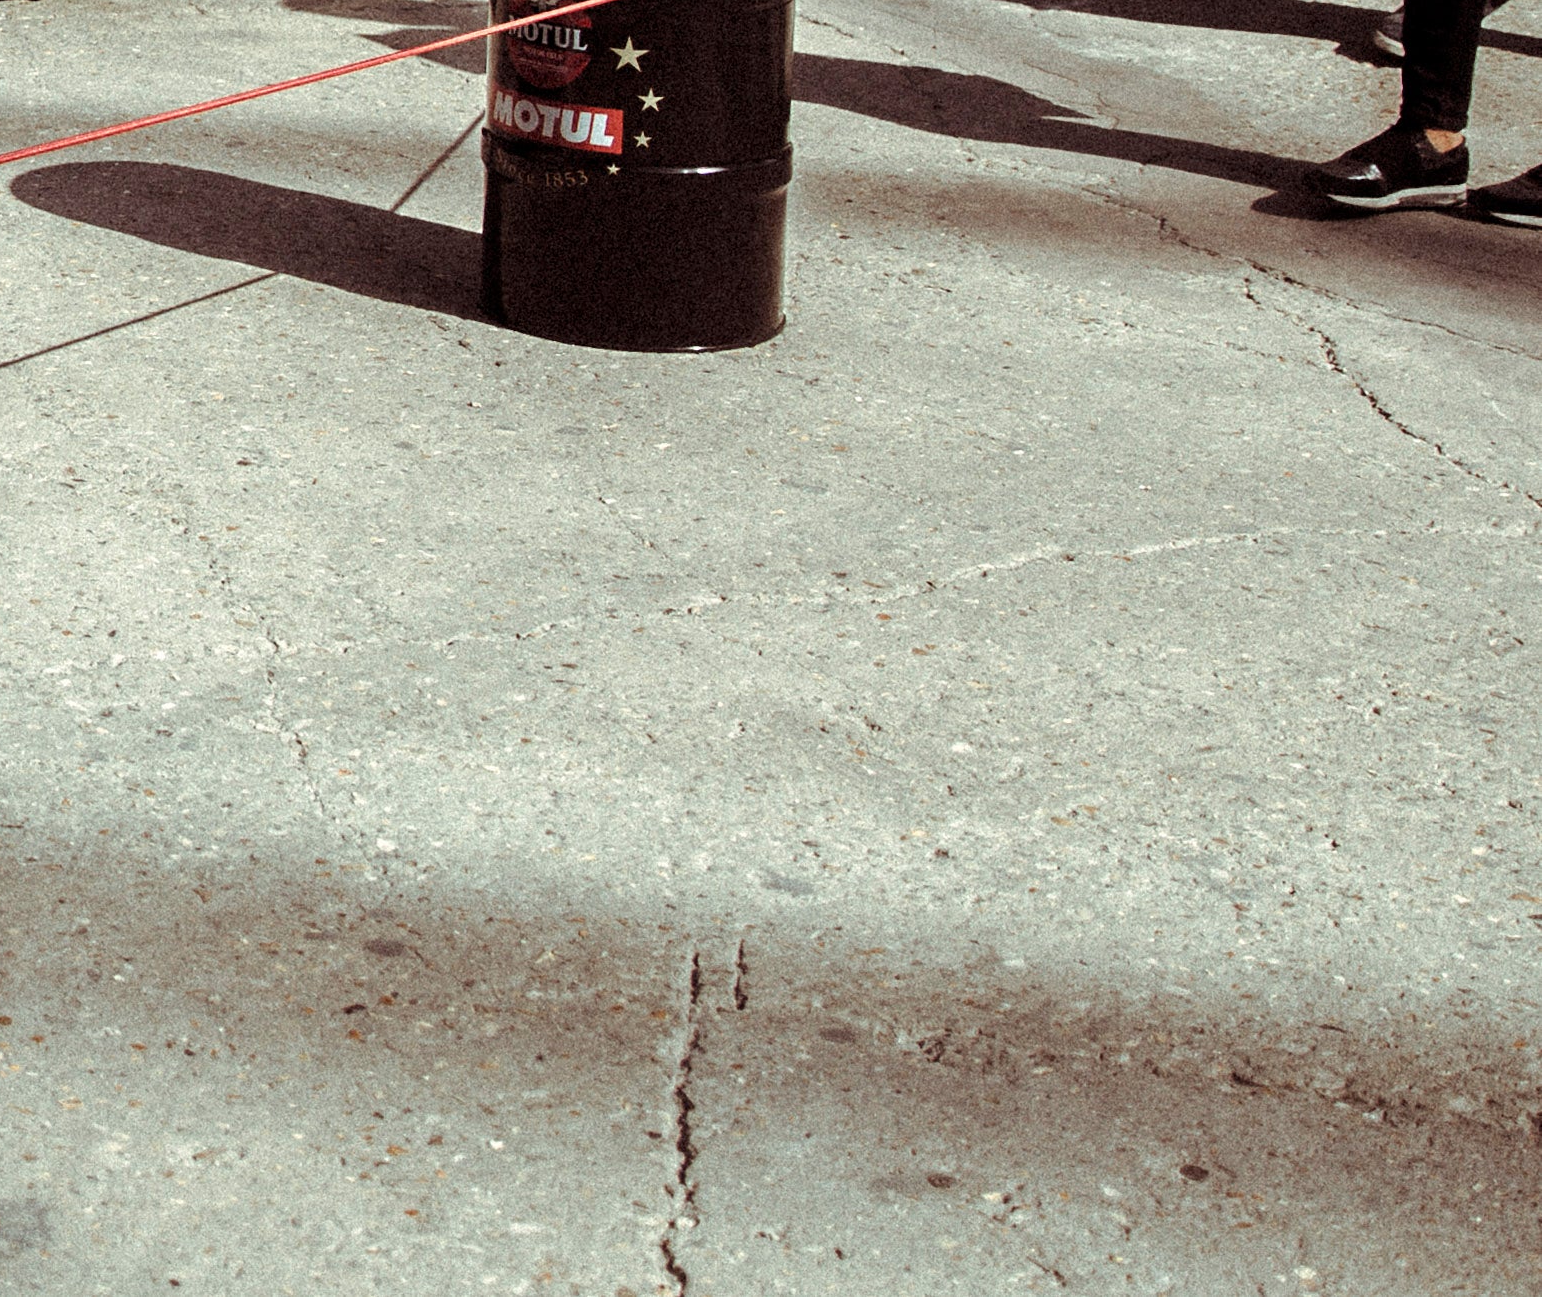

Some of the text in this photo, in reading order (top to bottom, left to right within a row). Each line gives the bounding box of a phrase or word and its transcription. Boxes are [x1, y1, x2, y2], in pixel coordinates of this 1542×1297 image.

[508, 15, 588, 51] MOTUL
[493, 89, 615, 148] MOTUL
[545, 170, 589, 187] 1853
